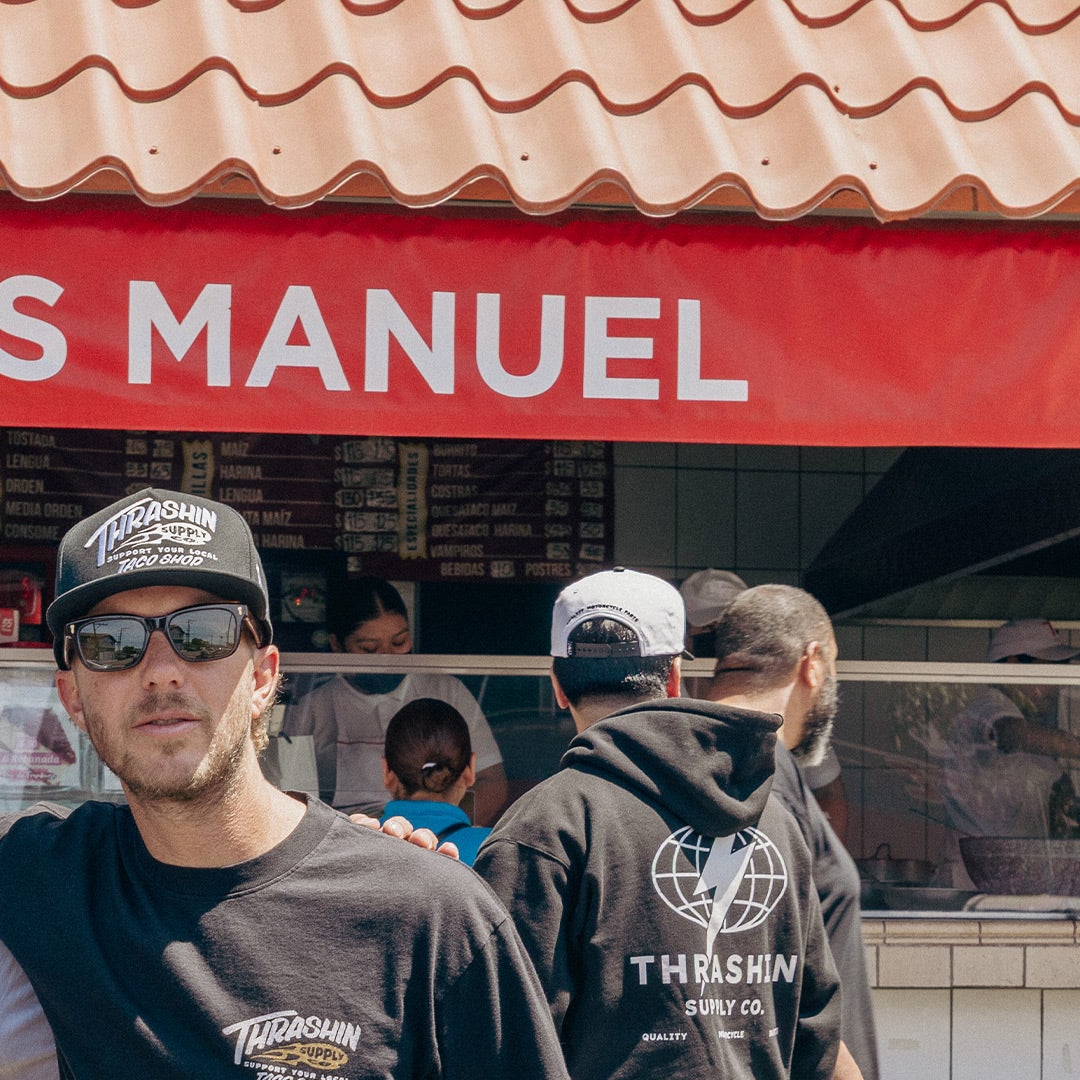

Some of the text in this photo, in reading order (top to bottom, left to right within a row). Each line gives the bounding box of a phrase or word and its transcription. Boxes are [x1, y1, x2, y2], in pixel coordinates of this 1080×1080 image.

[128, 280, 749, 402] MANUEL
[7, 431, 56, 448] TOSTADA
[6, 454, 50, 469] LENGUA
[220, 465, 262, 480] HARINA
[433, 464, 471, 478] TORTAS
[6, 479, 44, 493] ORDEN
[431, 485, 479, 498] COSTRAS
[219, 488, 263, 503] LENGUA
[406, 451, 419, 551] ESPECIALIDADES
[5, 501, 83, 518] MEDIA ORDEN
[263, 509, 293, 526] MAÍZ
[84, 497, 218, 566] THRASHIN
[161, 524, 207, 539] SUPPLY
[431, 524, 489, 537] QUESATACO
[494, 524, 533, 537] HARINA
[263, 533, 305, 549] HARINA
[107, 547, 152, 562] SUPPORT
[189, 549, 218, 561] LOCAL
[431, 544, 484, 558] VAMPIROS
[117, 554, 204, 574] TACO SHOP
[441, 562, 485, 576] BEBIDAS
[525, 563, 571, 577] POSTRES
[624, 610, 639, 623] PARTS
[630, 954, 798, 985] THRASHIN
[741, 999, 765, 1016] CO.
[222, 1010, 362, 1065] THRASHIN
[642, 1032, 688, 1042] QUALITY
[299, 1046, 345, 1061] SUPPLY
[244, 1061, 287, 1074] SUPPORT
[291, 1069, 316, 1079] YOUR
